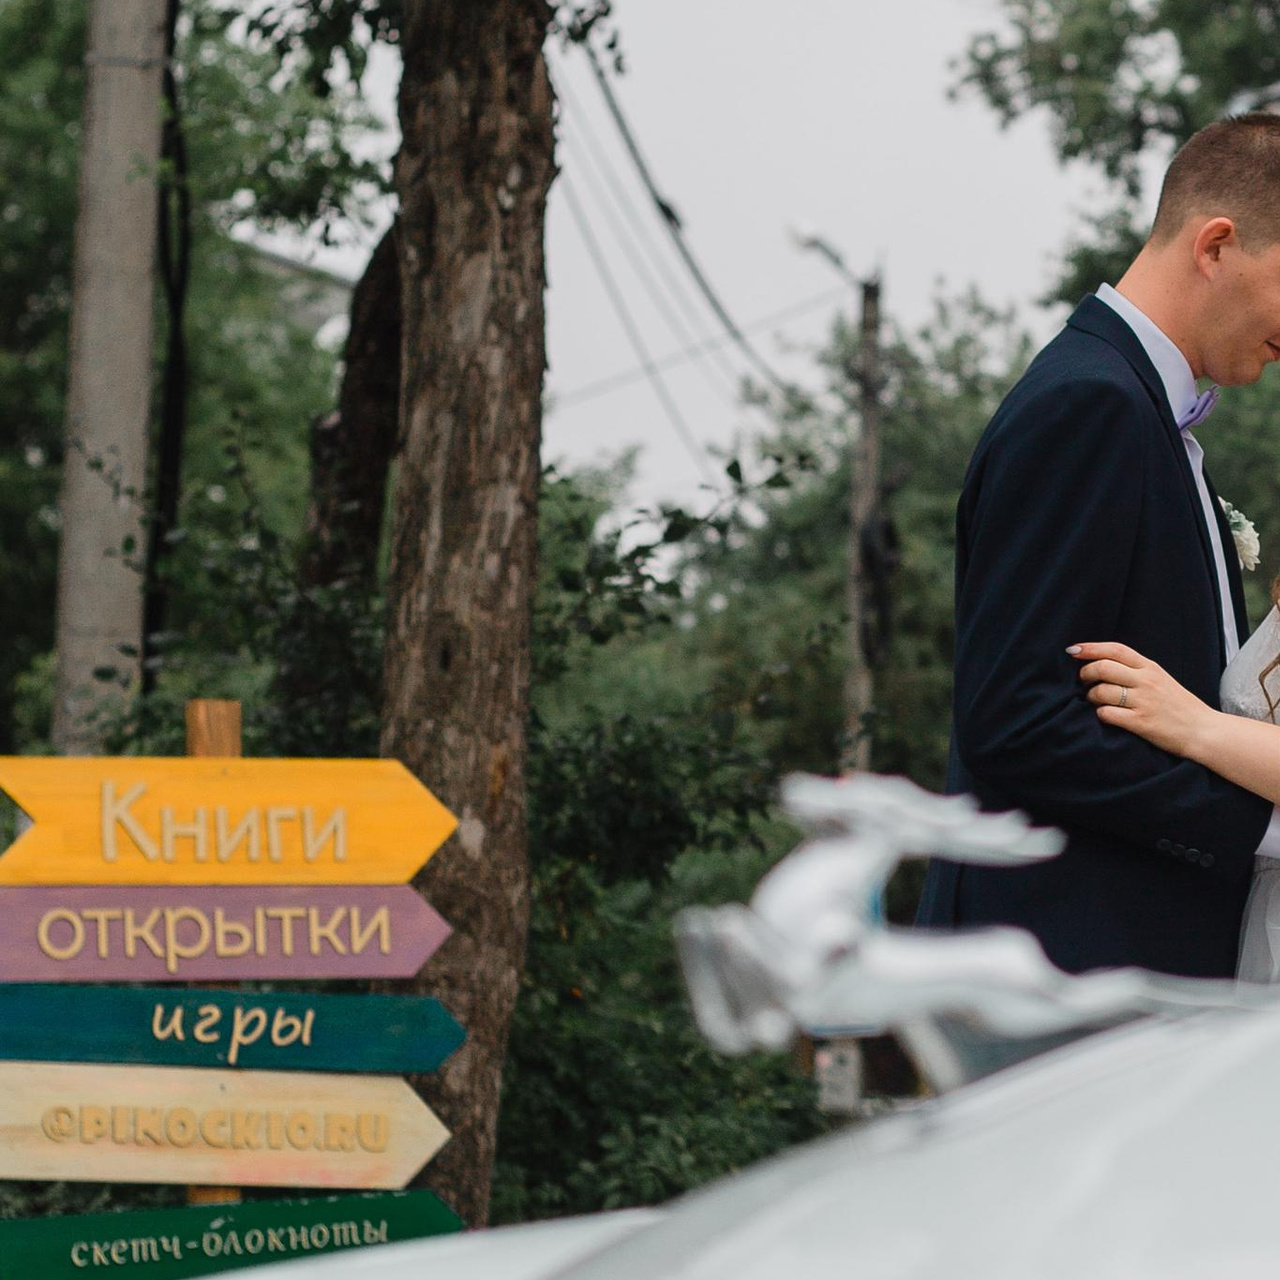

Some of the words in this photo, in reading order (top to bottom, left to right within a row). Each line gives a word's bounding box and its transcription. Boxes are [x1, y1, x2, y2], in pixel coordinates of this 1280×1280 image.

[102, 780, 348, 862] Книги
[37, 906, 392, 974] открытки
[152, 1003, 315, 1065] игры
[70, 1218, 389, 1268] скетч-блокноты
